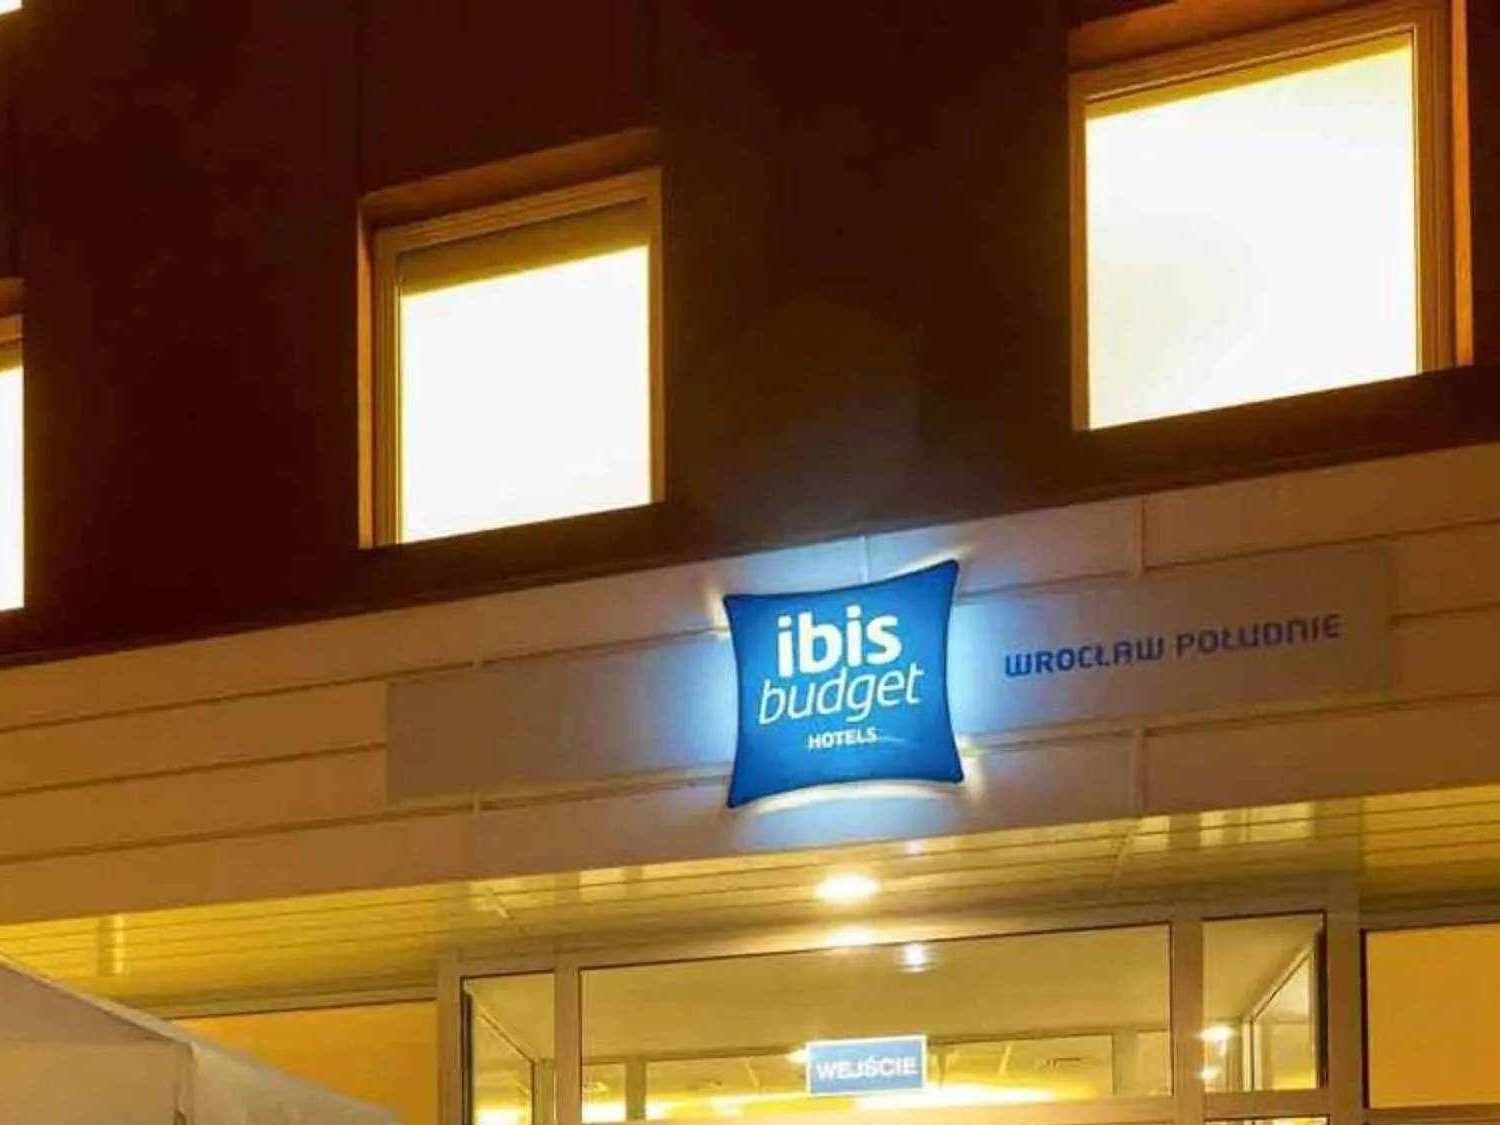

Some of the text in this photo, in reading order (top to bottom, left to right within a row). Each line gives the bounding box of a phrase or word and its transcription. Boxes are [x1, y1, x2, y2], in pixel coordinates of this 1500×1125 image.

[777, 604, 902, 677] ibis
[758, 663, 924, 725] budget
[807, 727, 878, 750] HOTELS
[816, 1055, 918, 1080] WEJŚCIE
